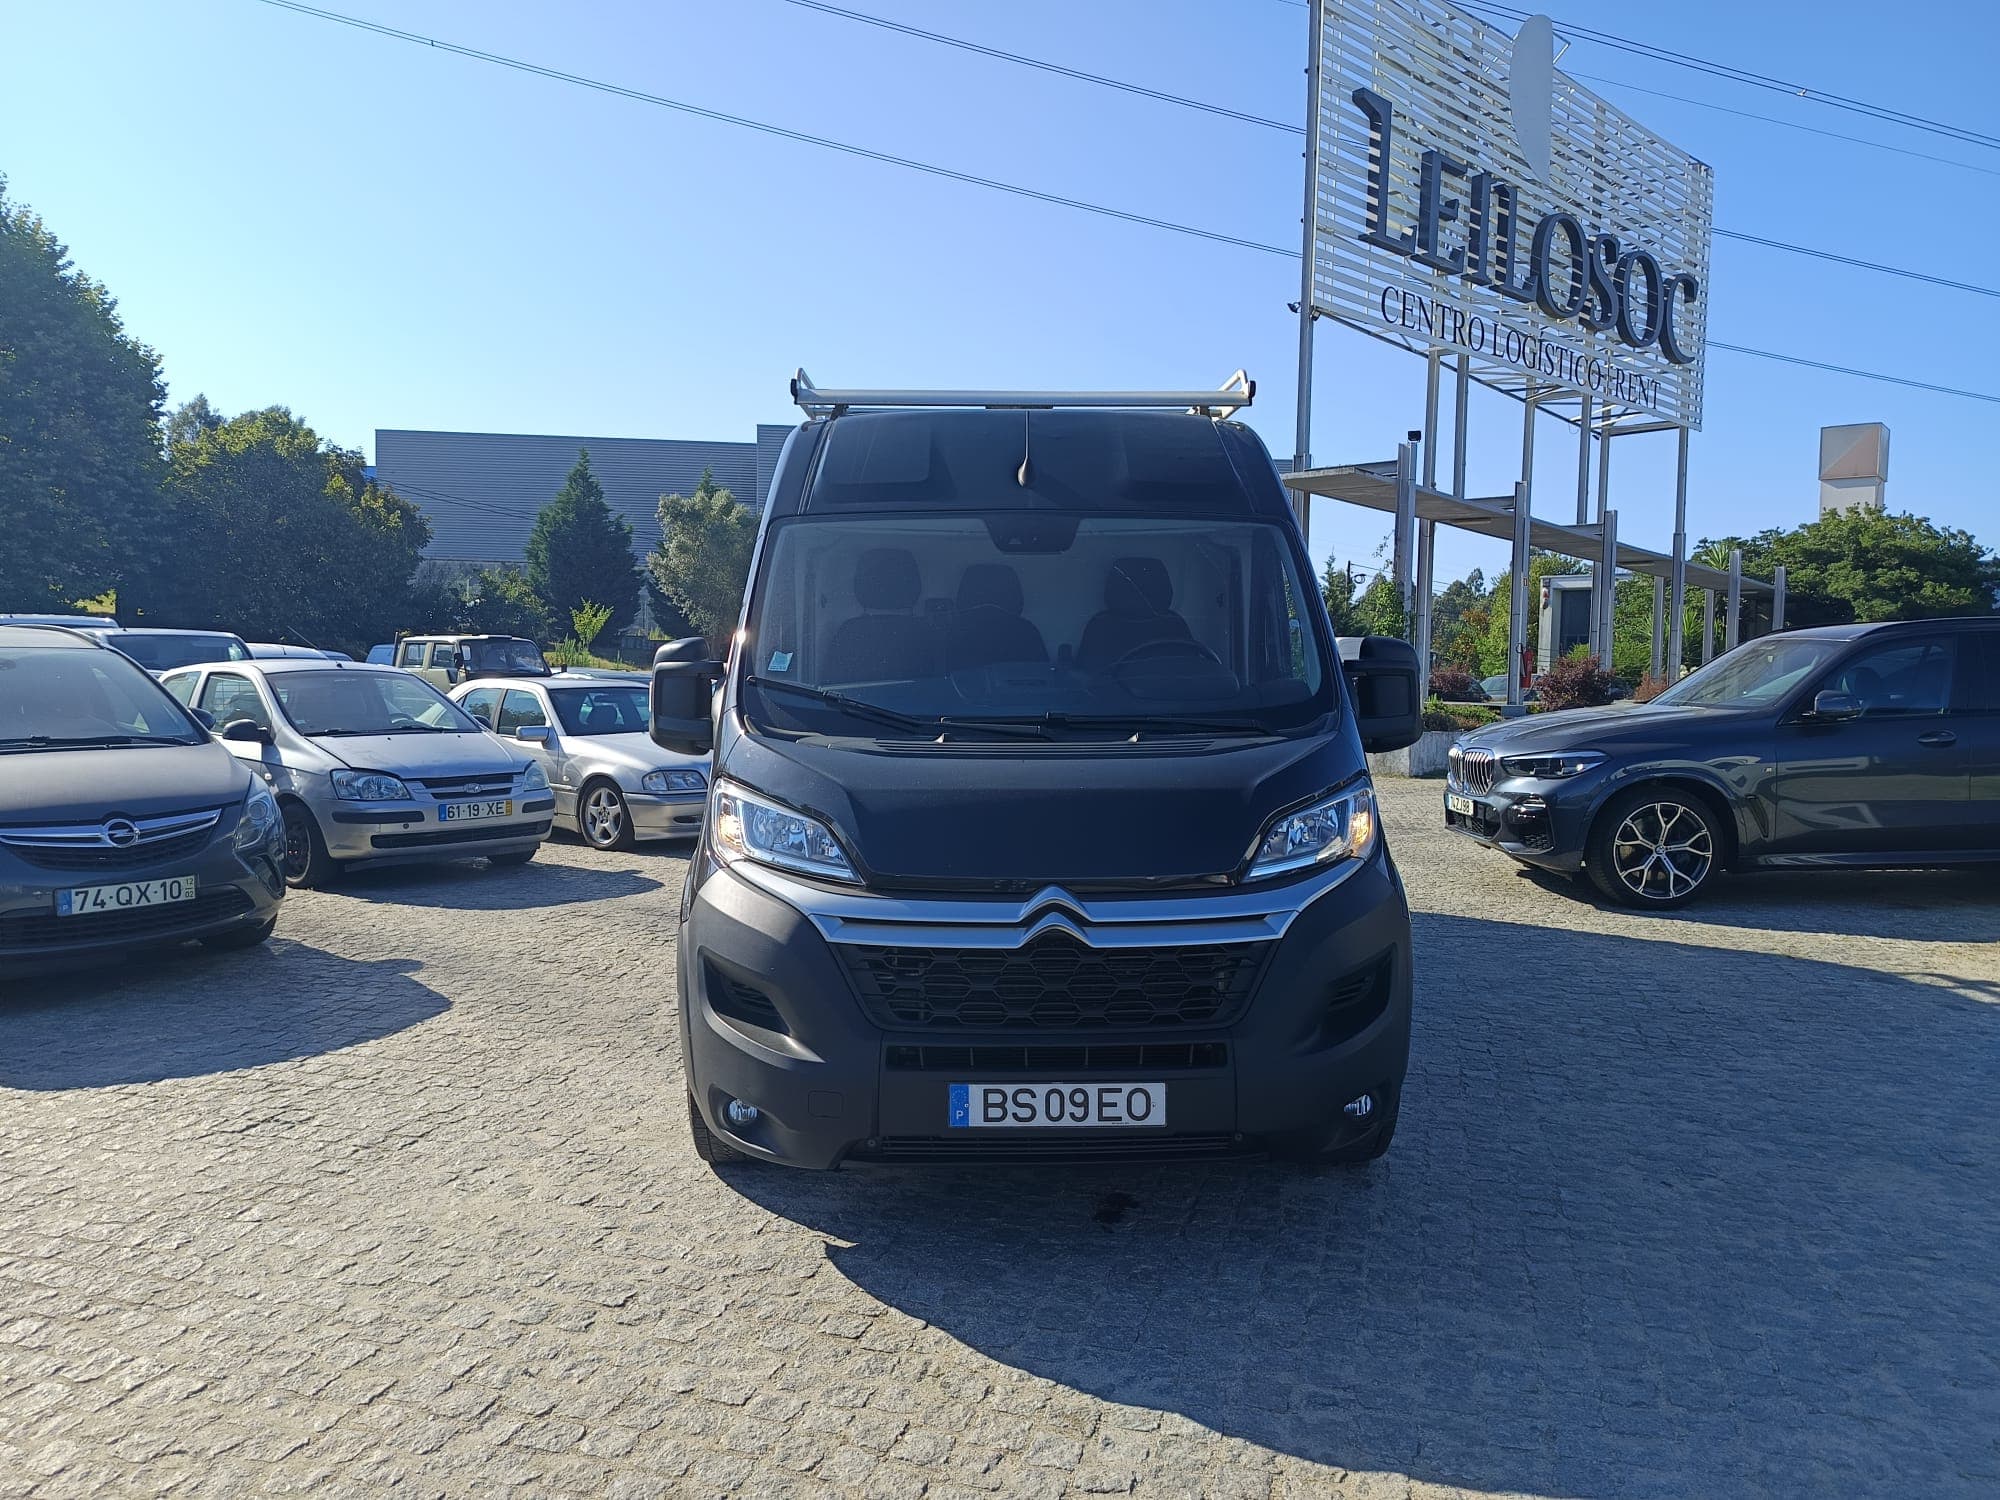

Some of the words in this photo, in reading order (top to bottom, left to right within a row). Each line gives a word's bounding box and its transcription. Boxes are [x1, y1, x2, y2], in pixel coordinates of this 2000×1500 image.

[1352, 87, 1698, 364] LEILOSOC
[1381, 286, 1485, 351] CENTRO
[1492, 323, 1601, 391] LOGÍSTICO
[1614, 367, 1661, 409] RENT
[956, 1110, 964, 1120] P
